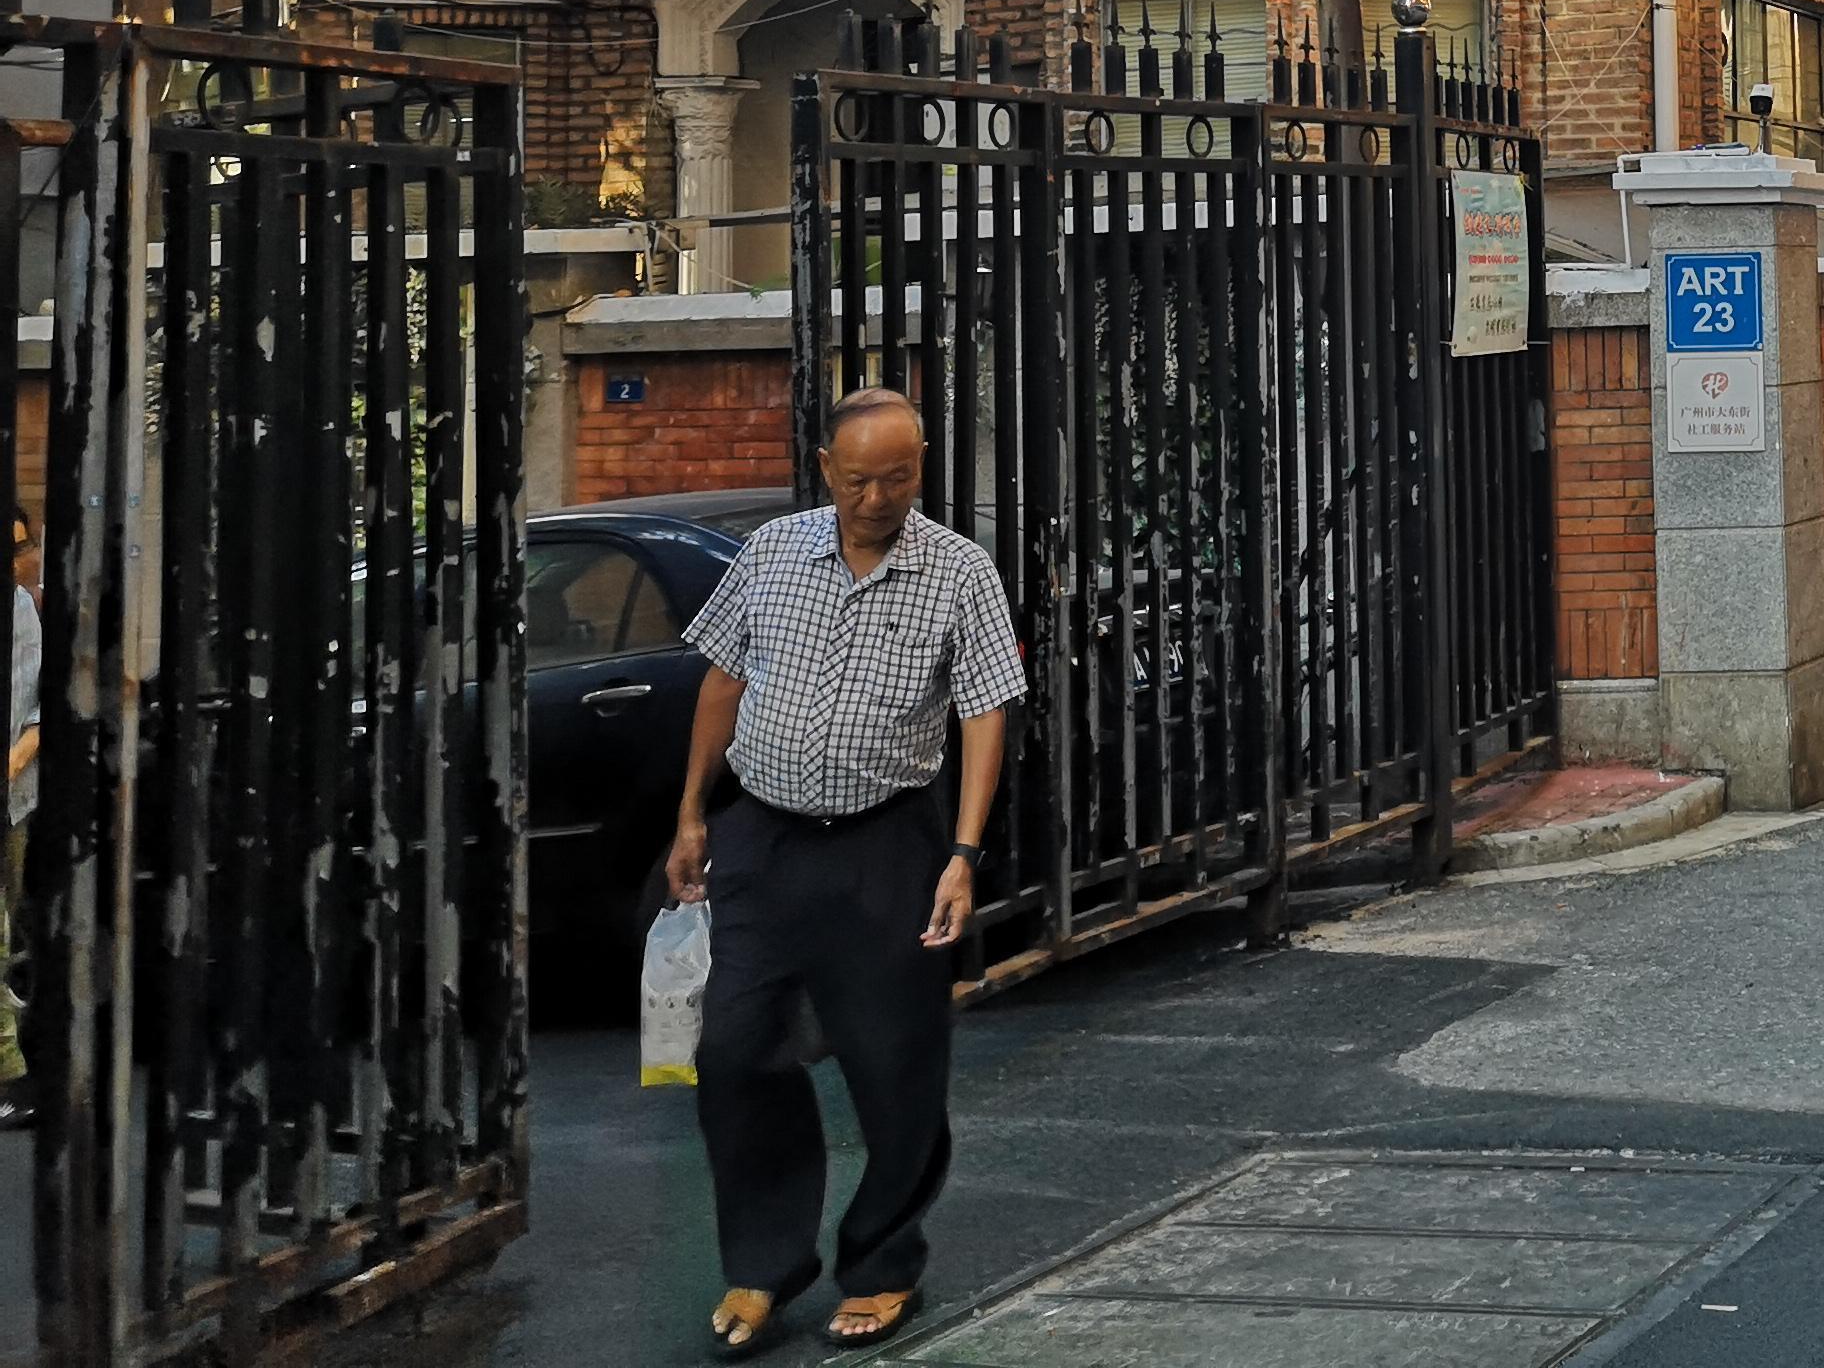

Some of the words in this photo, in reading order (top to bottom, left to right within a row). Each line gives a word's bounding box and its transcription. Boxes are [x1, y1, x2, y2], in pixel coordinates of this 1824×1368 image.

[1676, 265, 1750, 296] ART
[1692, 302, 1736, 333] 23
[619, 383, 631, 399] 2
